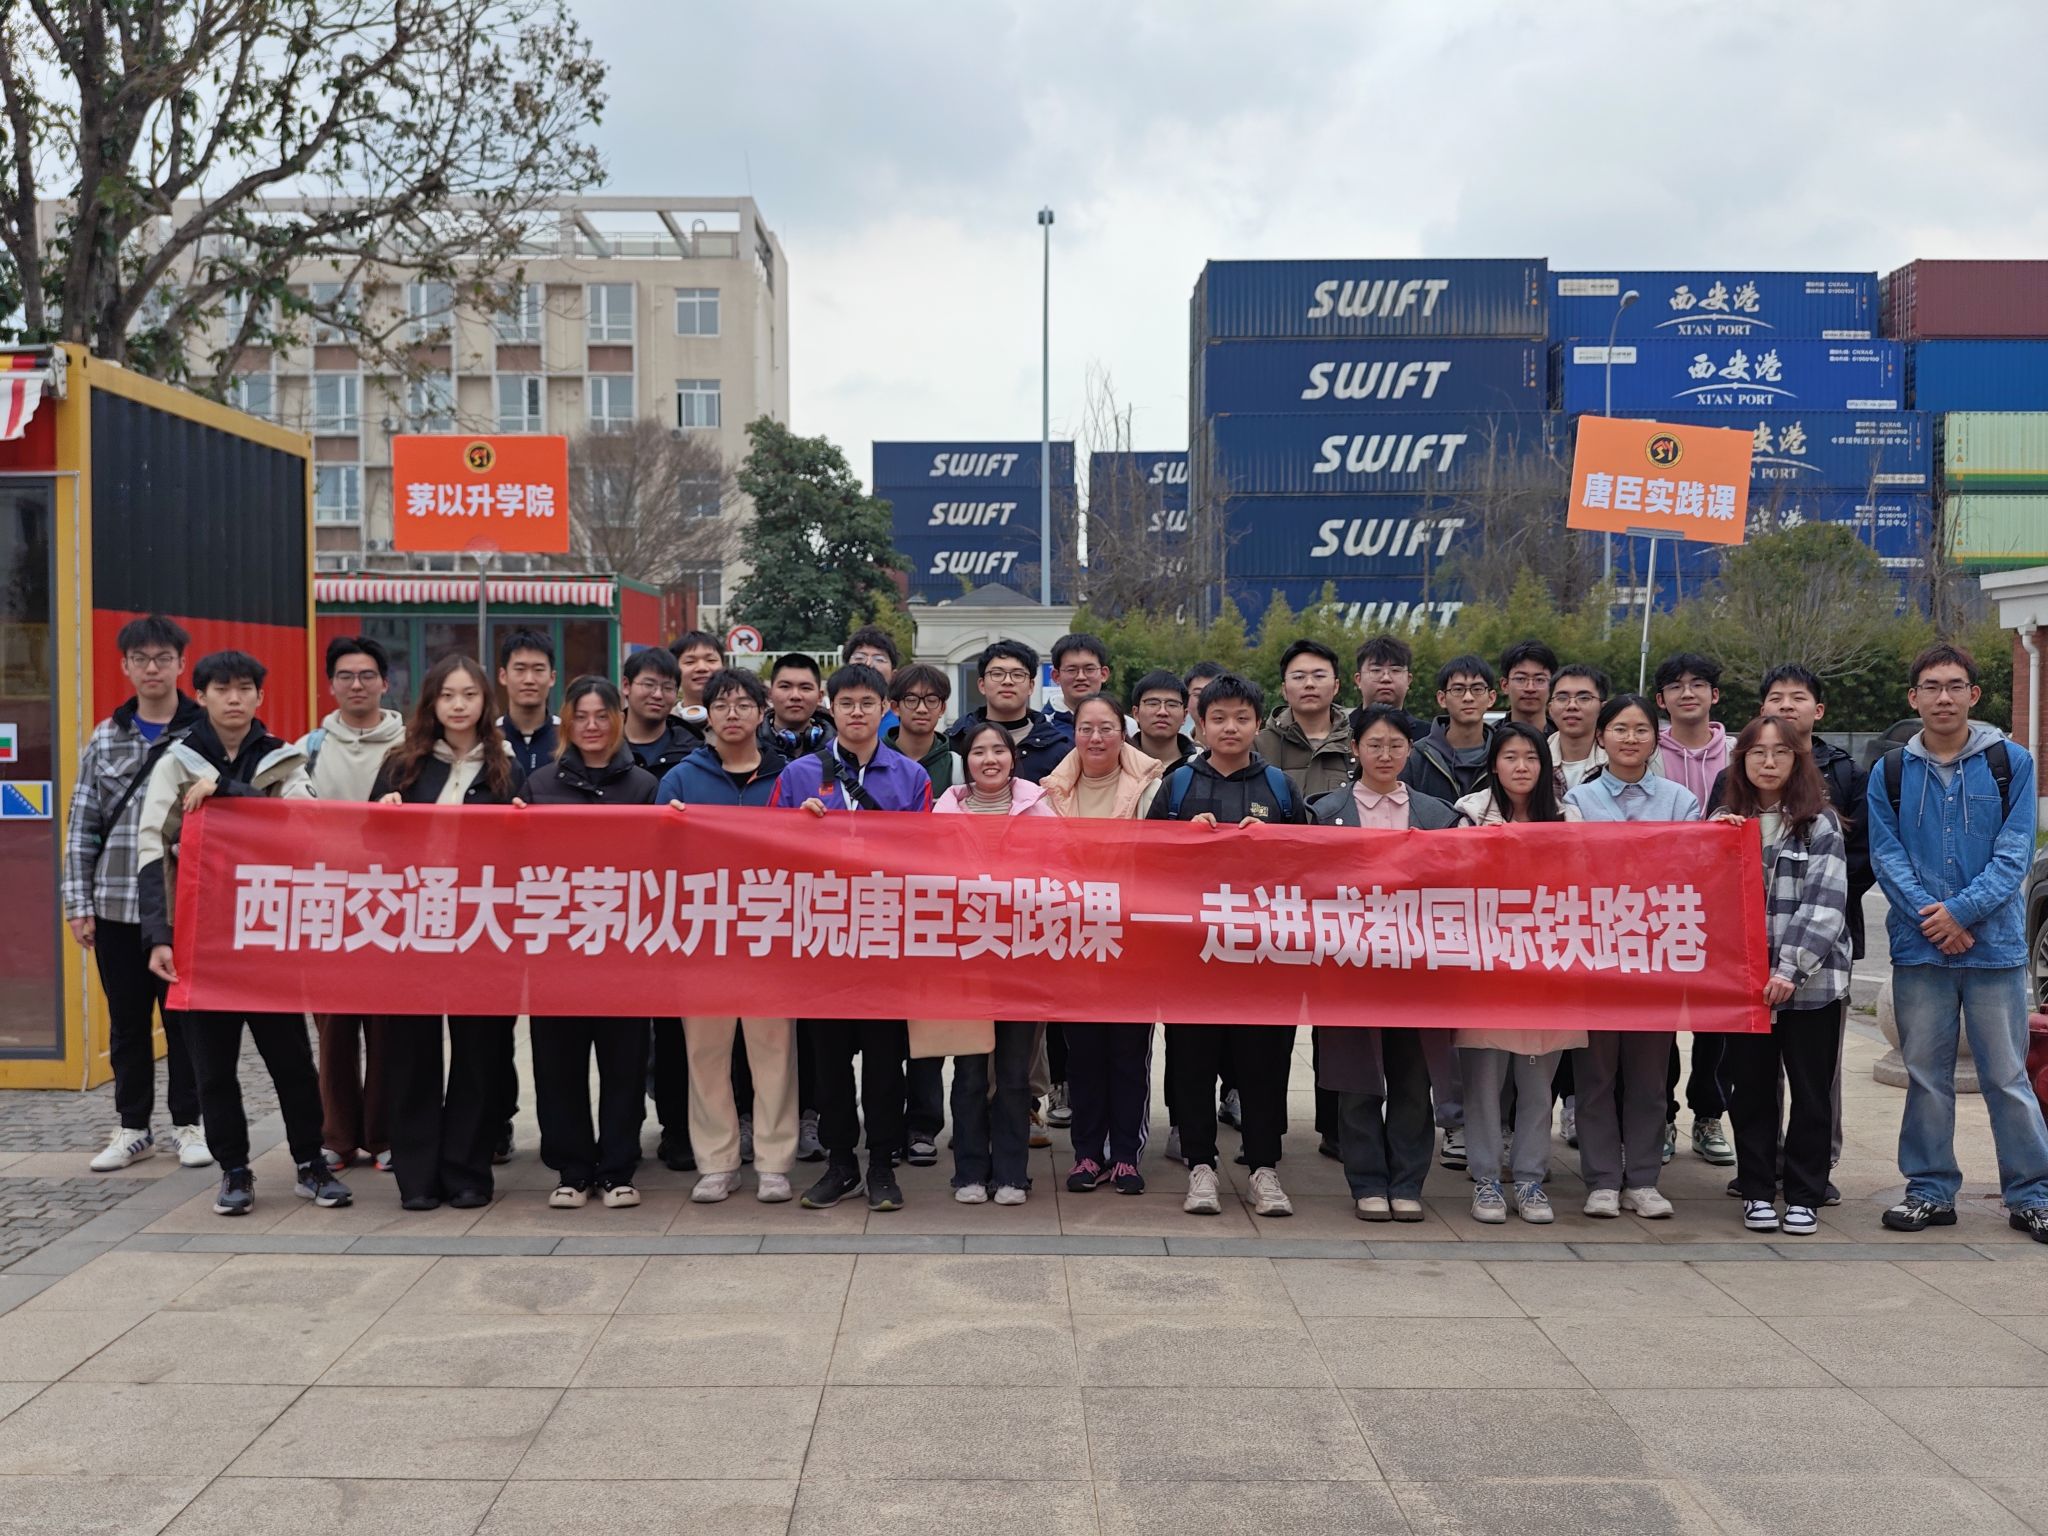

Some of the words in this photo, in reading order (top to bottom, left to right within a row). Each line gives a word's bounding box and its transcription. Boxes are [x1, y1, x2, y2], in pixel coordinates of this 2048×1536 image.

[1308, 280, 1449, 318] SWIFT
[1669, 280, 1760, 313] 西安港
[1678, 325, 1712, 335] XI'AN
[1717, 325, 1752, 335] PORT
[1301, 361, 1452, 400] SWIFT
[1688, 349, 1782, 382] 西安港
[1697, 394, 1733, 405] XI'AN
[1738, 394, 1774, 405] PORT
[929, 453, 1019, 477] SWIFT
[1312, 434, 1468, 474] SWIFT
[1761, 467, 1799, 479] PORT
[406, 482, 555, 518] 茅以升学院
[1582, 472, 1736, 521] 唐臣实践课
[928, 502, 1017, 526] SWIFT
[1310, 518, 1465, 557] SWIFT
[929, 551, 1019, 575] SWIFT
